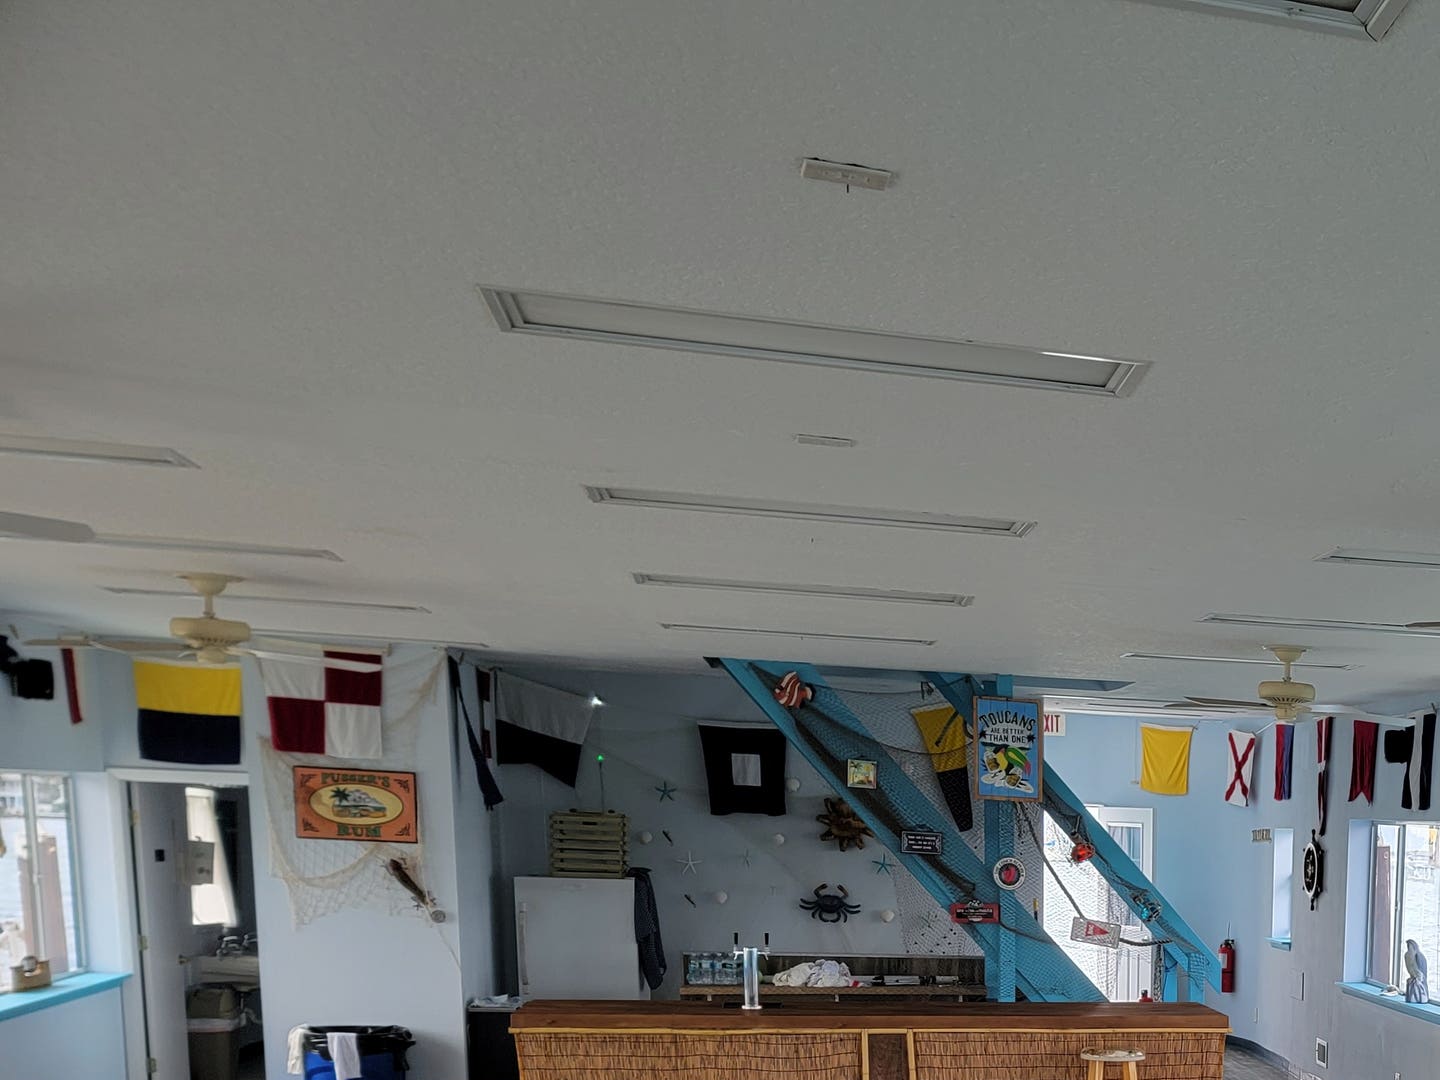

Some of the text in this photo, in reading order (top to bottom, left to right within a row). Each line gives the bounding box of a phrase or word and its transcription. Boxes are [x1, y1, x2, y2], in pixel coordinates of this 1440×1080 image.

[979, 711, 1036, 732] TOUCANS
[1043, 714, 1061, 733] XIT
[989, 734, 1026, 744] THAN ONE
[336, 824, 382, 838] RUM
